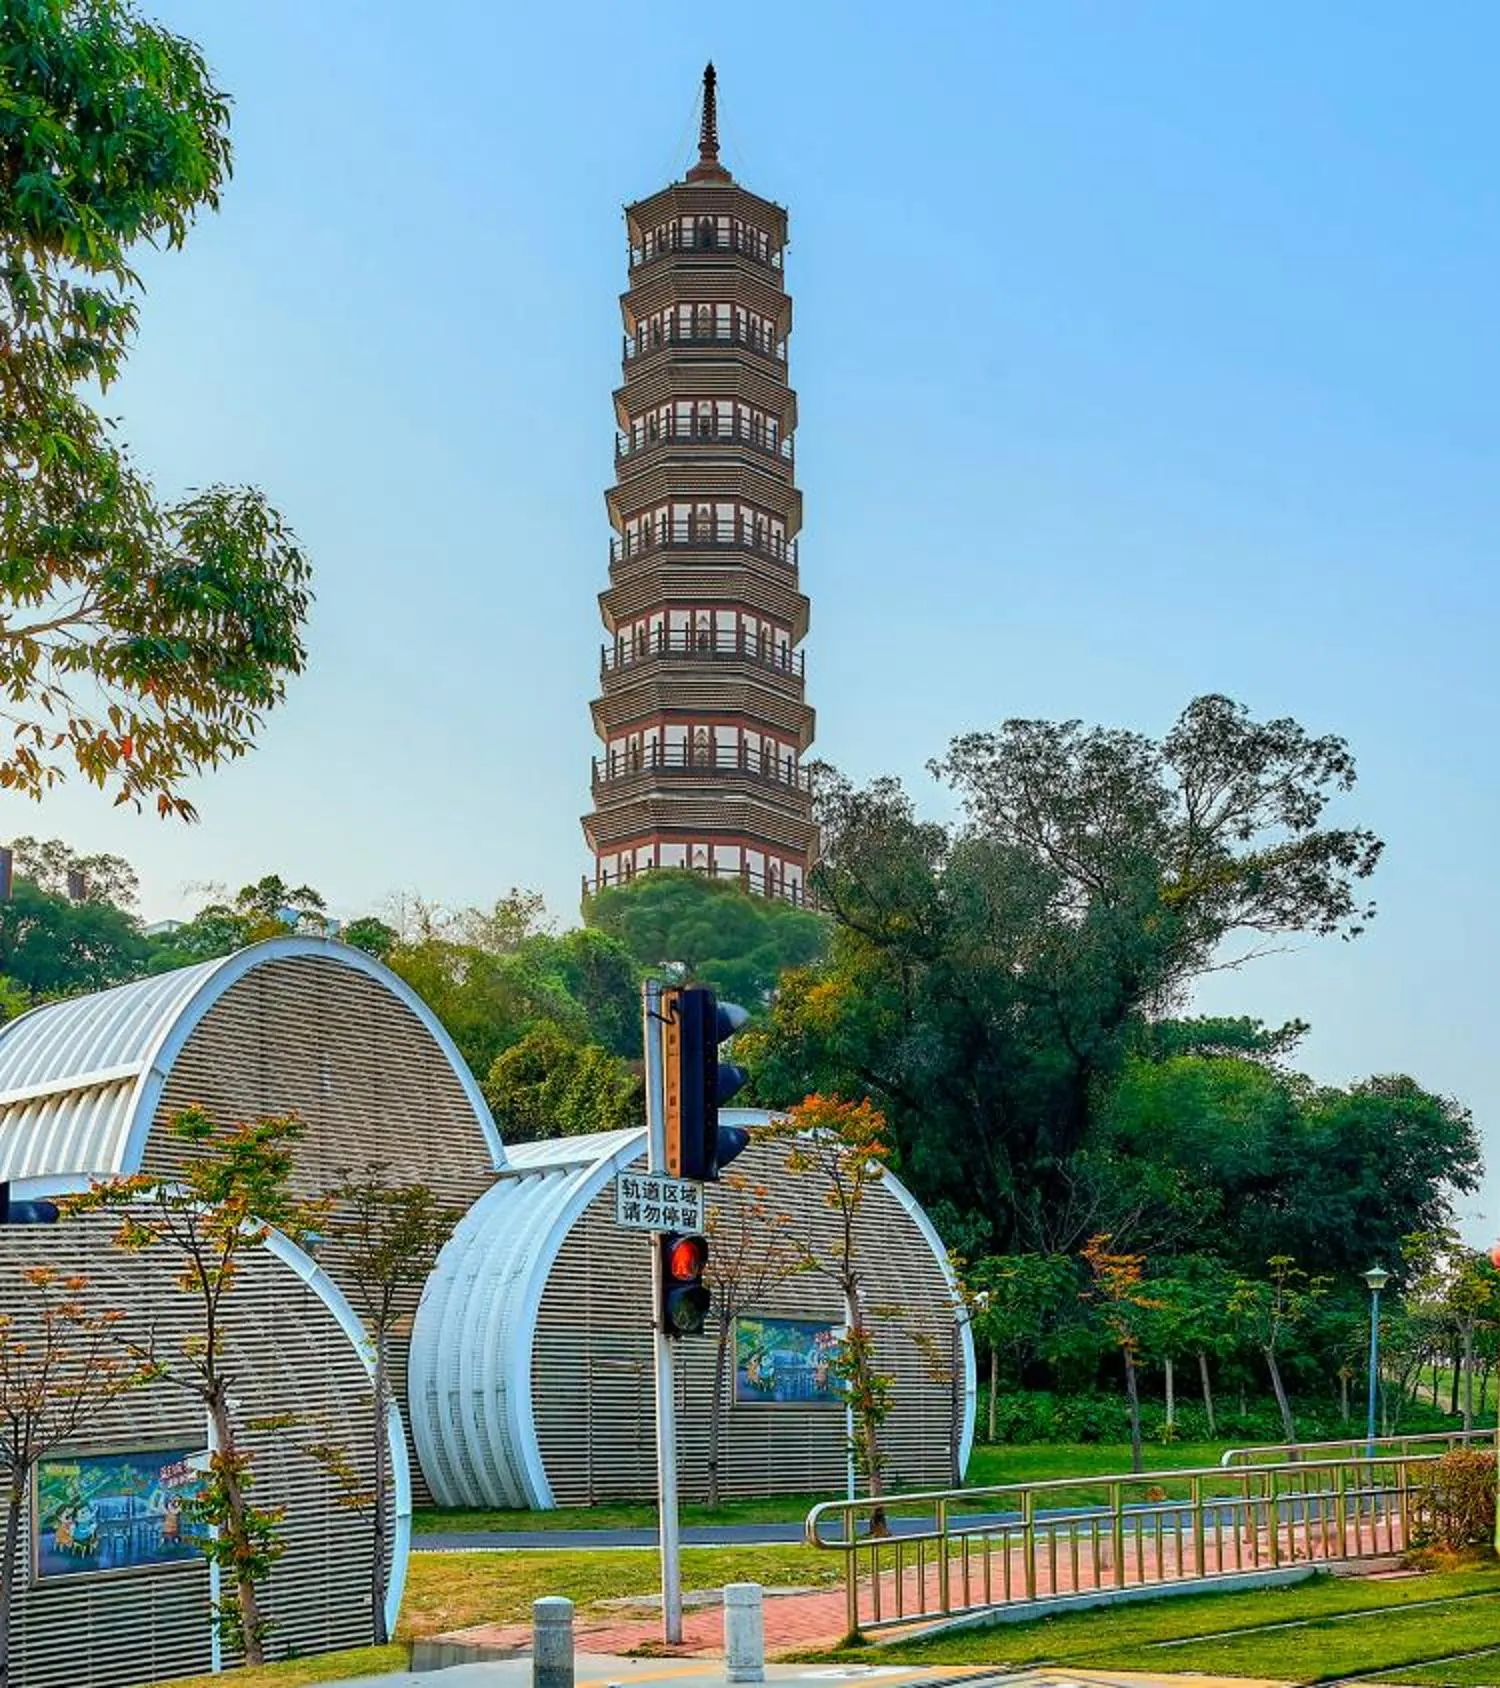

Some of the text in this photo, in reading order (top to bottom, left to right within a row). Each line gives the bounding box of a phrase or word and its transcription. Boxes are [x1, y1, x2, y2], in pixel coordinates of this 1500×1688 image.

[622, 1179, 698, 1206] 轨道区域
[622, 1202, 697, 1228] 请勿停留
